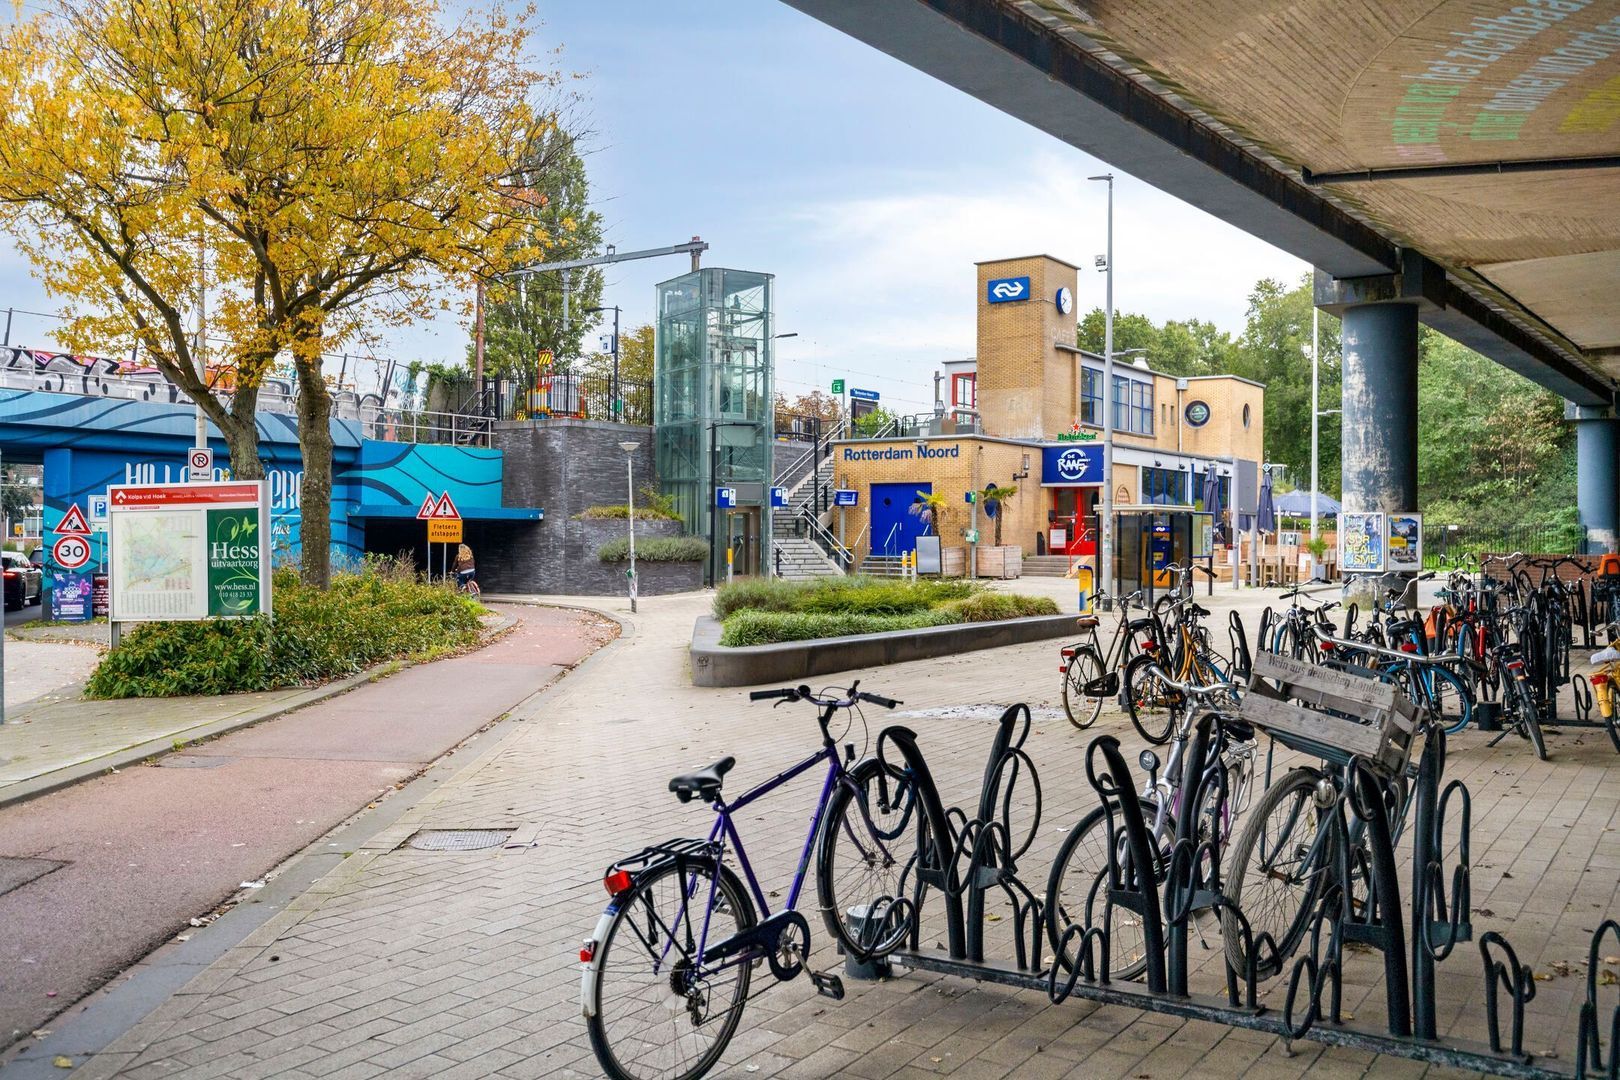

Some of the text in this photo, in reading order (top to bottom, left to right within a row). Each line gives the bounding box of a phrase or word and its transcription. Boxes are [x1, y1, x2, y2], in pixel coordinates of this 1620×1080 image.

[1434, 0, 1594, 63] zichtbaa
[844, 444, 959, 461] Rotterdam Noord
[60, 545, 84, 558] 30
[211, 541, 258, 560] Hess
[211, 560, 258, 569] uitvaartzorg
[214, 582, 256, 590] www.hess.nl
[1268, 655, 1386, 697] Wein aus deutschen Landen
